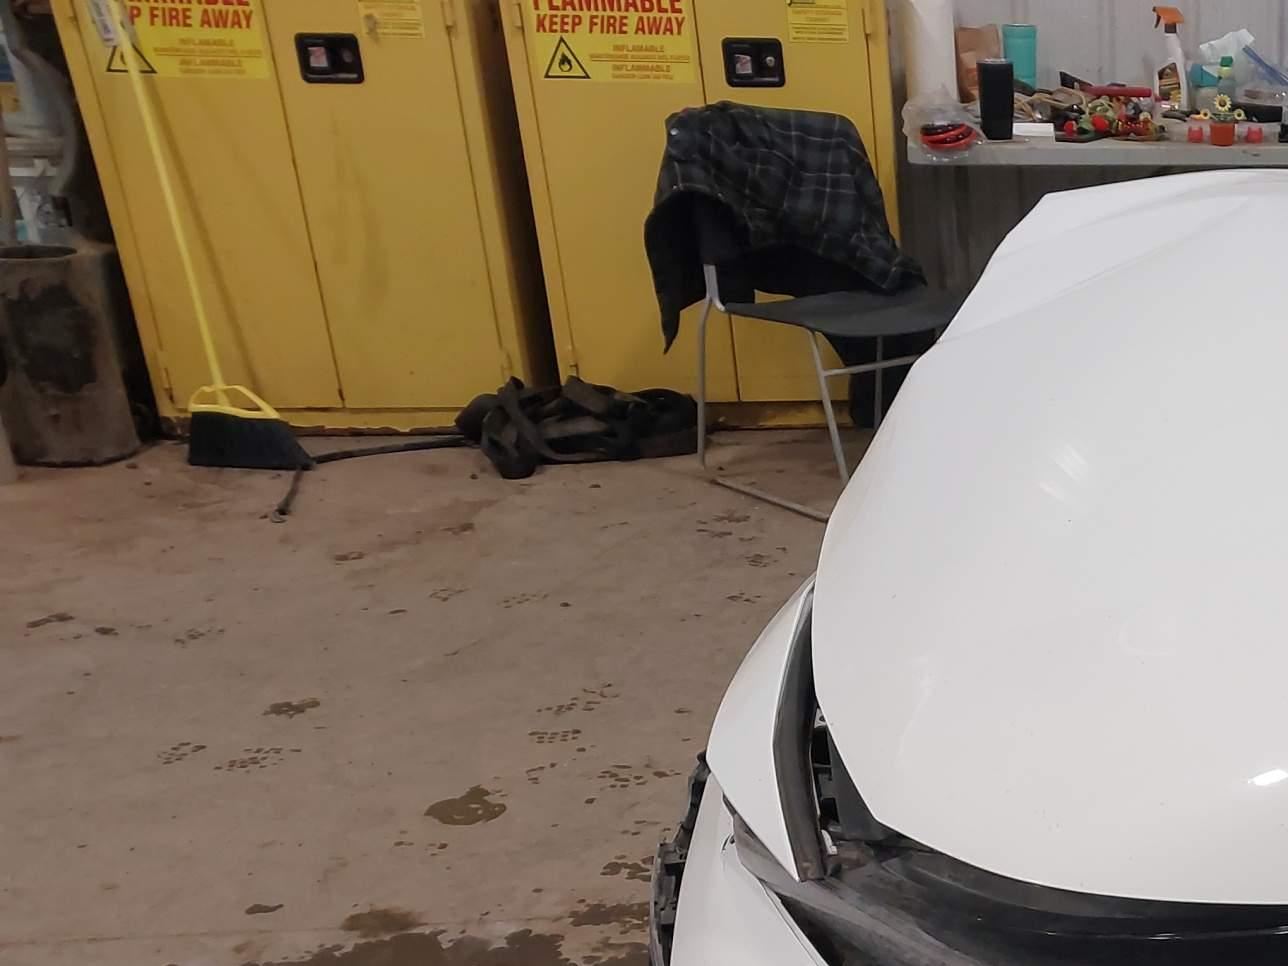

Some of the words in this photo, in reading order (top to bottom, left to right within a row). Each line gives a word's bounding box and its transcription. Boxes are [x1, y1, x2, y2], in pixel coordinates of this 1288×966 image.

[150, 7, 193, 28] FIRE
[200, 8, 254, 29] AWAY
[536, 13, 582, 34] KEEP
[589, 15, 629, 35] FIRE
[635, 16, 686, 36] AWAY
